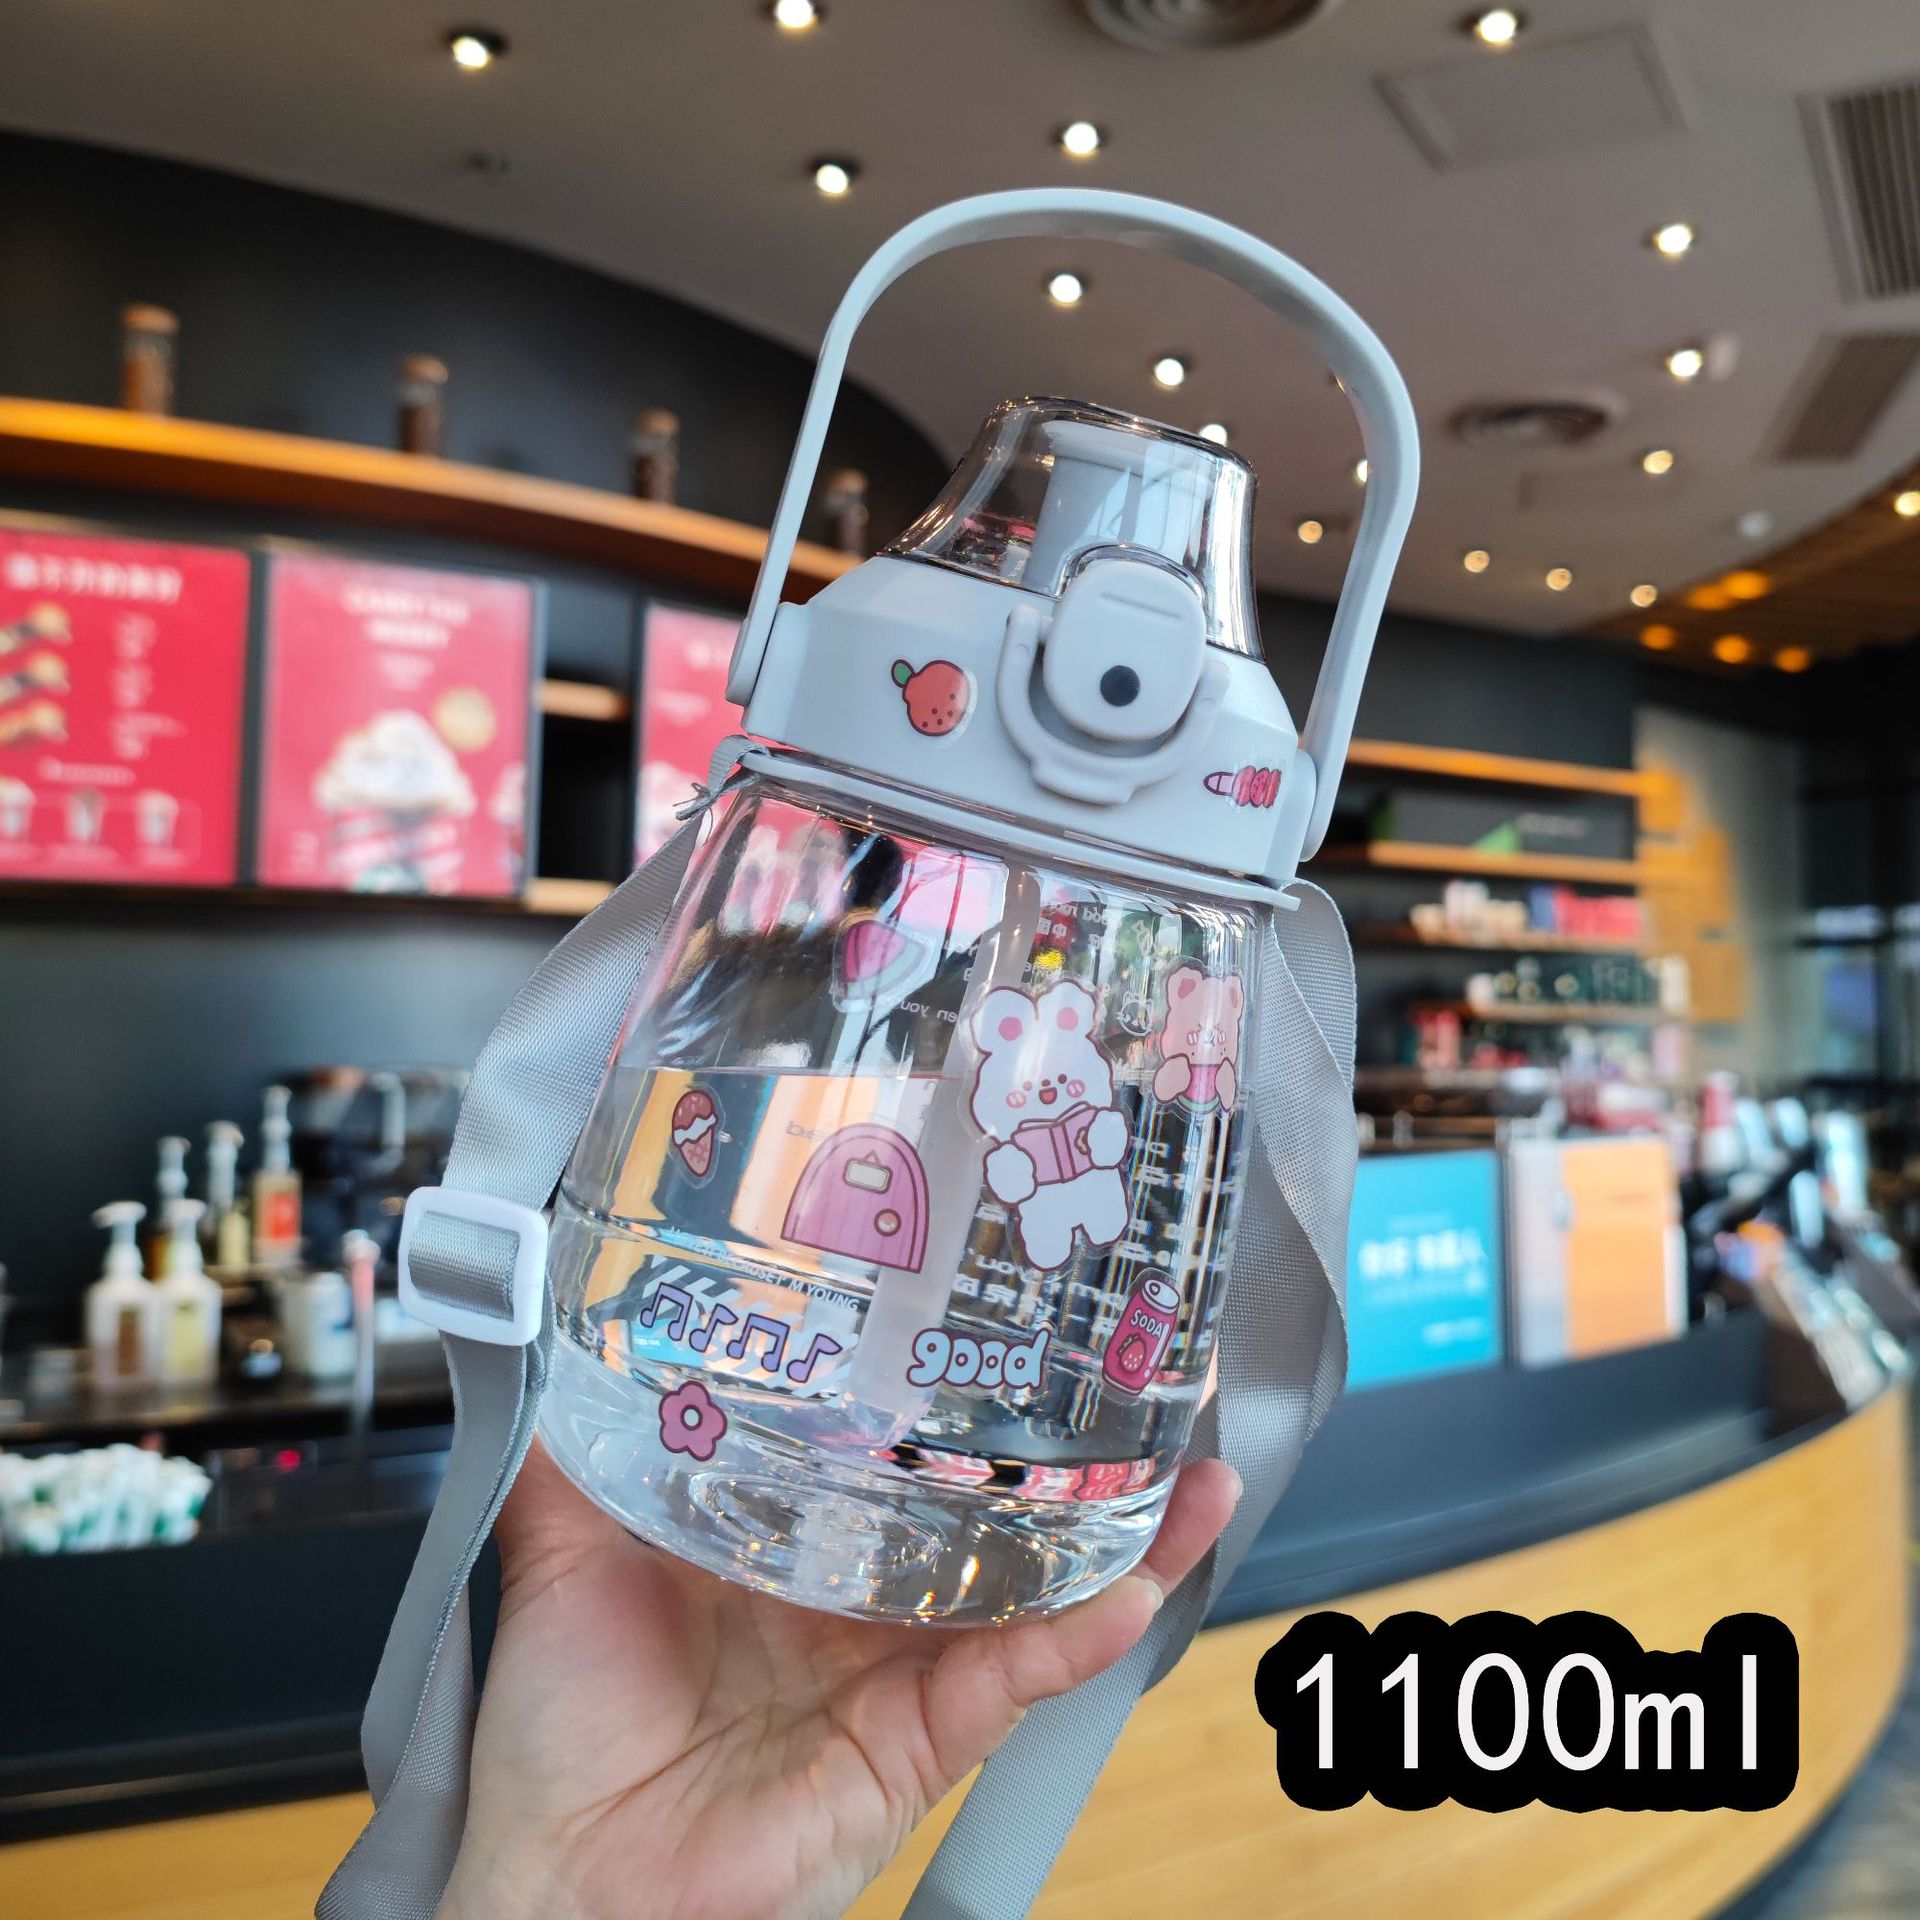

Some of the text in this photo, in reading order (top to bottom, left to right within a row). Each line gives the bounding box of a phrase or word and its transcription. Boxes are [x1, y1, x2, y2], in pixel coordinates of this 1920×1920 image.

[805, 1283, 861, 1312] YOUNG
[1130, 1308, 1164, 1339] SODA
[906, 1327, 1051, 1389] good
